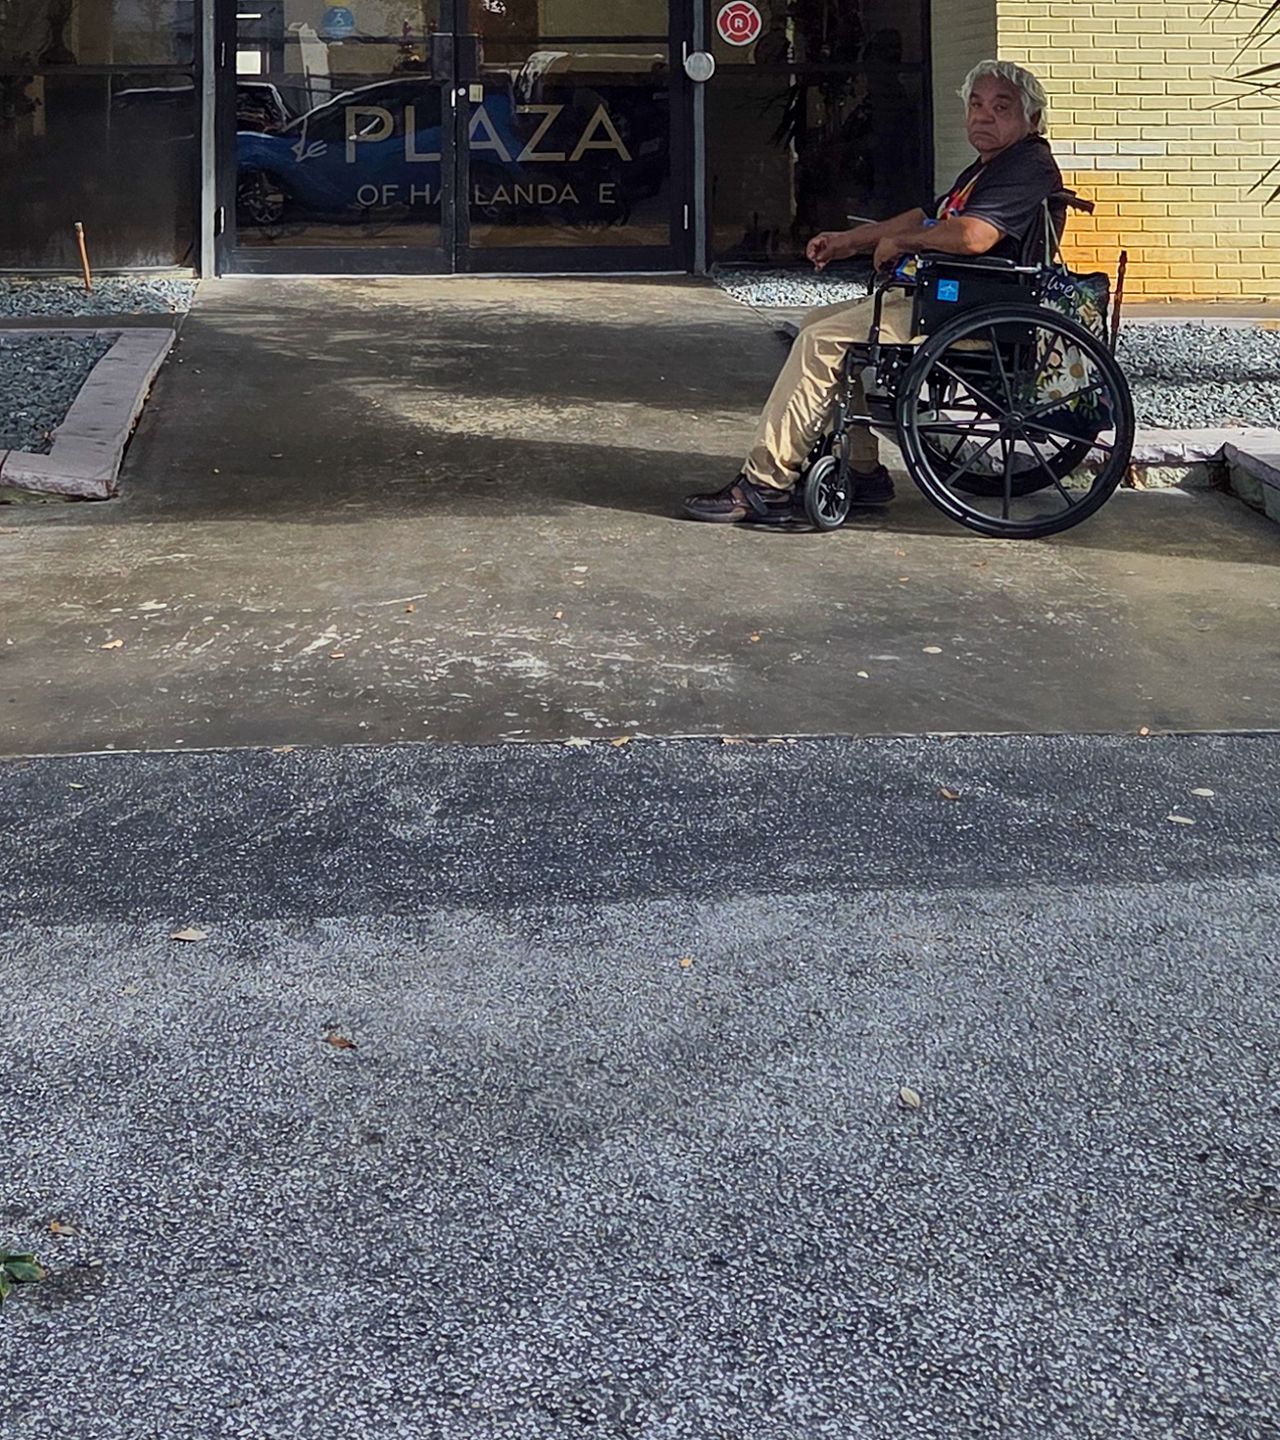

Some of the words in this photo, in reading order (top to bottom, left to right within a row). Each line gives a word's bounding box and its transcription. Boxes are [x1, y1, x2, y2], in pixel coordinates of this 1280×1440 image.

[734, 18, 744, 28] R
[345, 104, 633, 163] PLAZA
[356, 183, 399, 206] OF
